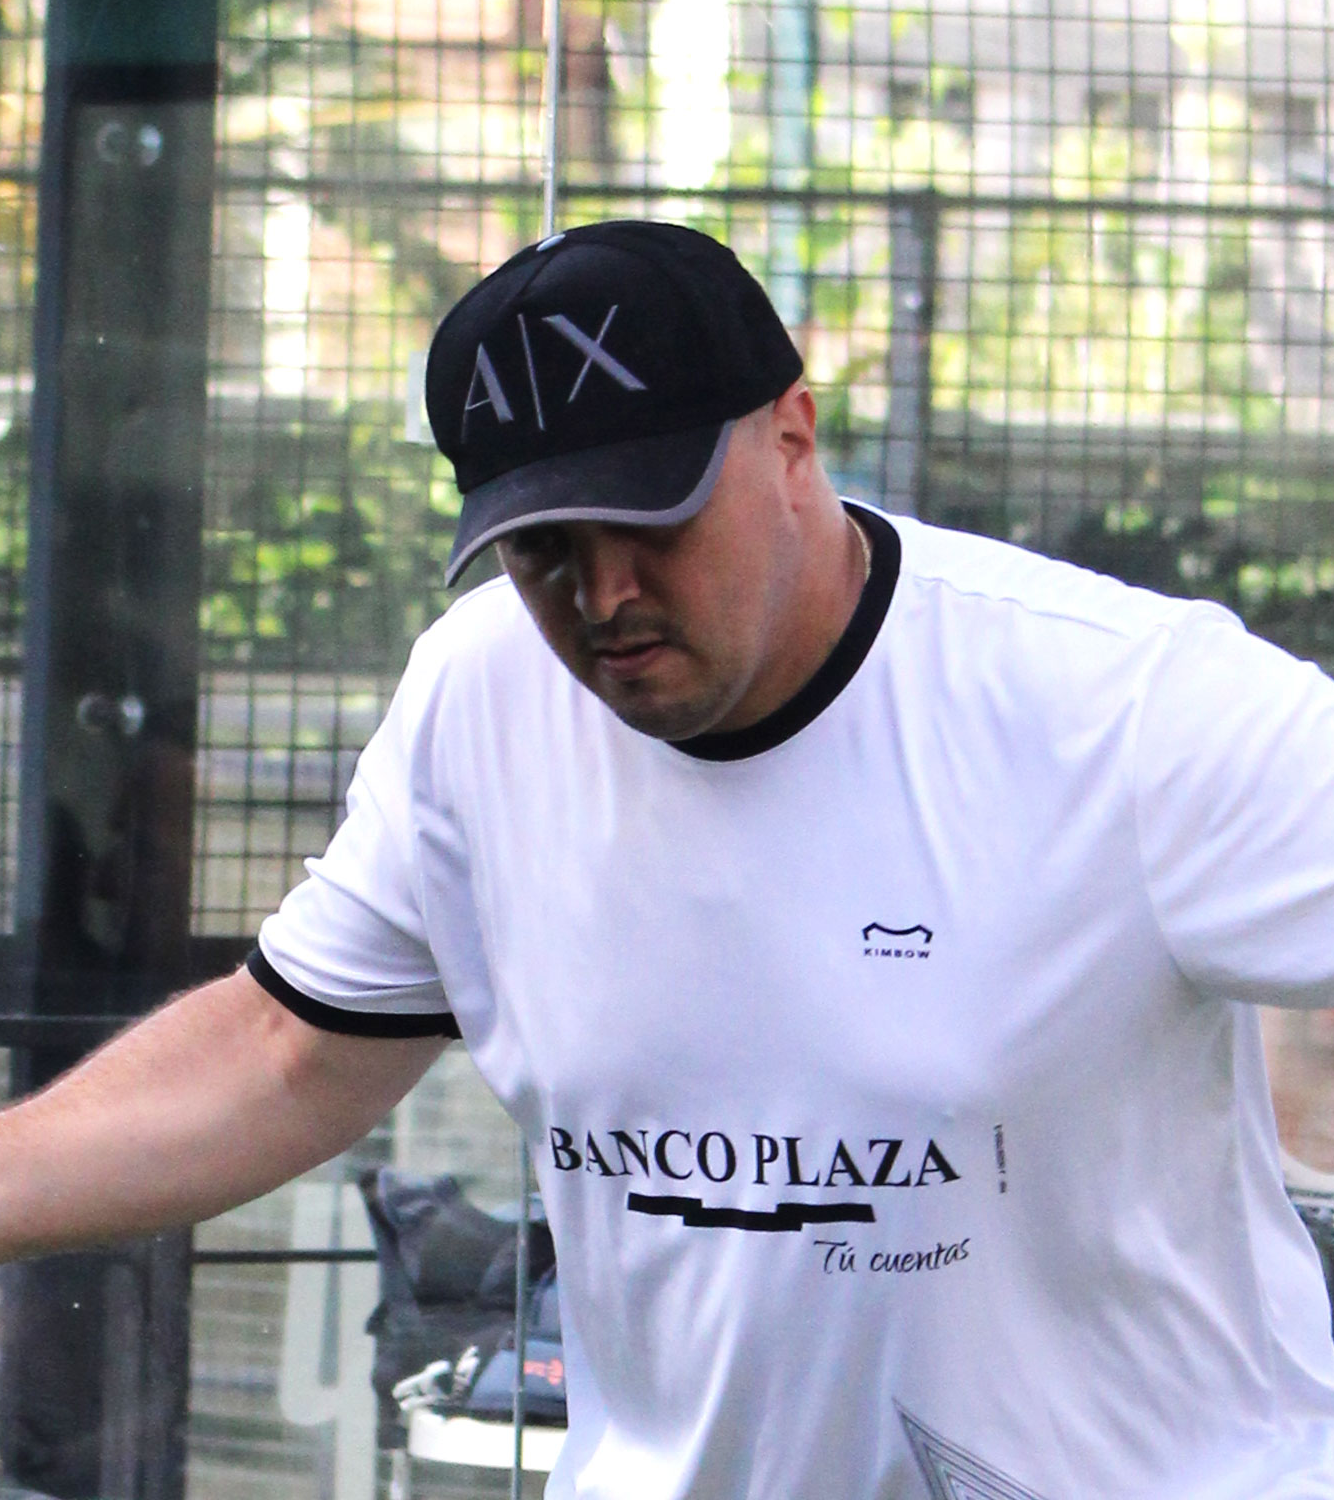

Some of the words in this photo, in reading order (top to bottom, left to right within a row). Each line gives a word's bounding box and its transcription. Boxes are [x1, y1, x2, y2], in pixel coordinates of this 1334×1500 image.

[864, 948, 931, 960] KIMBOW
[549, 1127, 737, 1184] BANCO
[752, 1132, 962, 1188] PLAZA
[870, 1237, 972, 1274] cuentas
